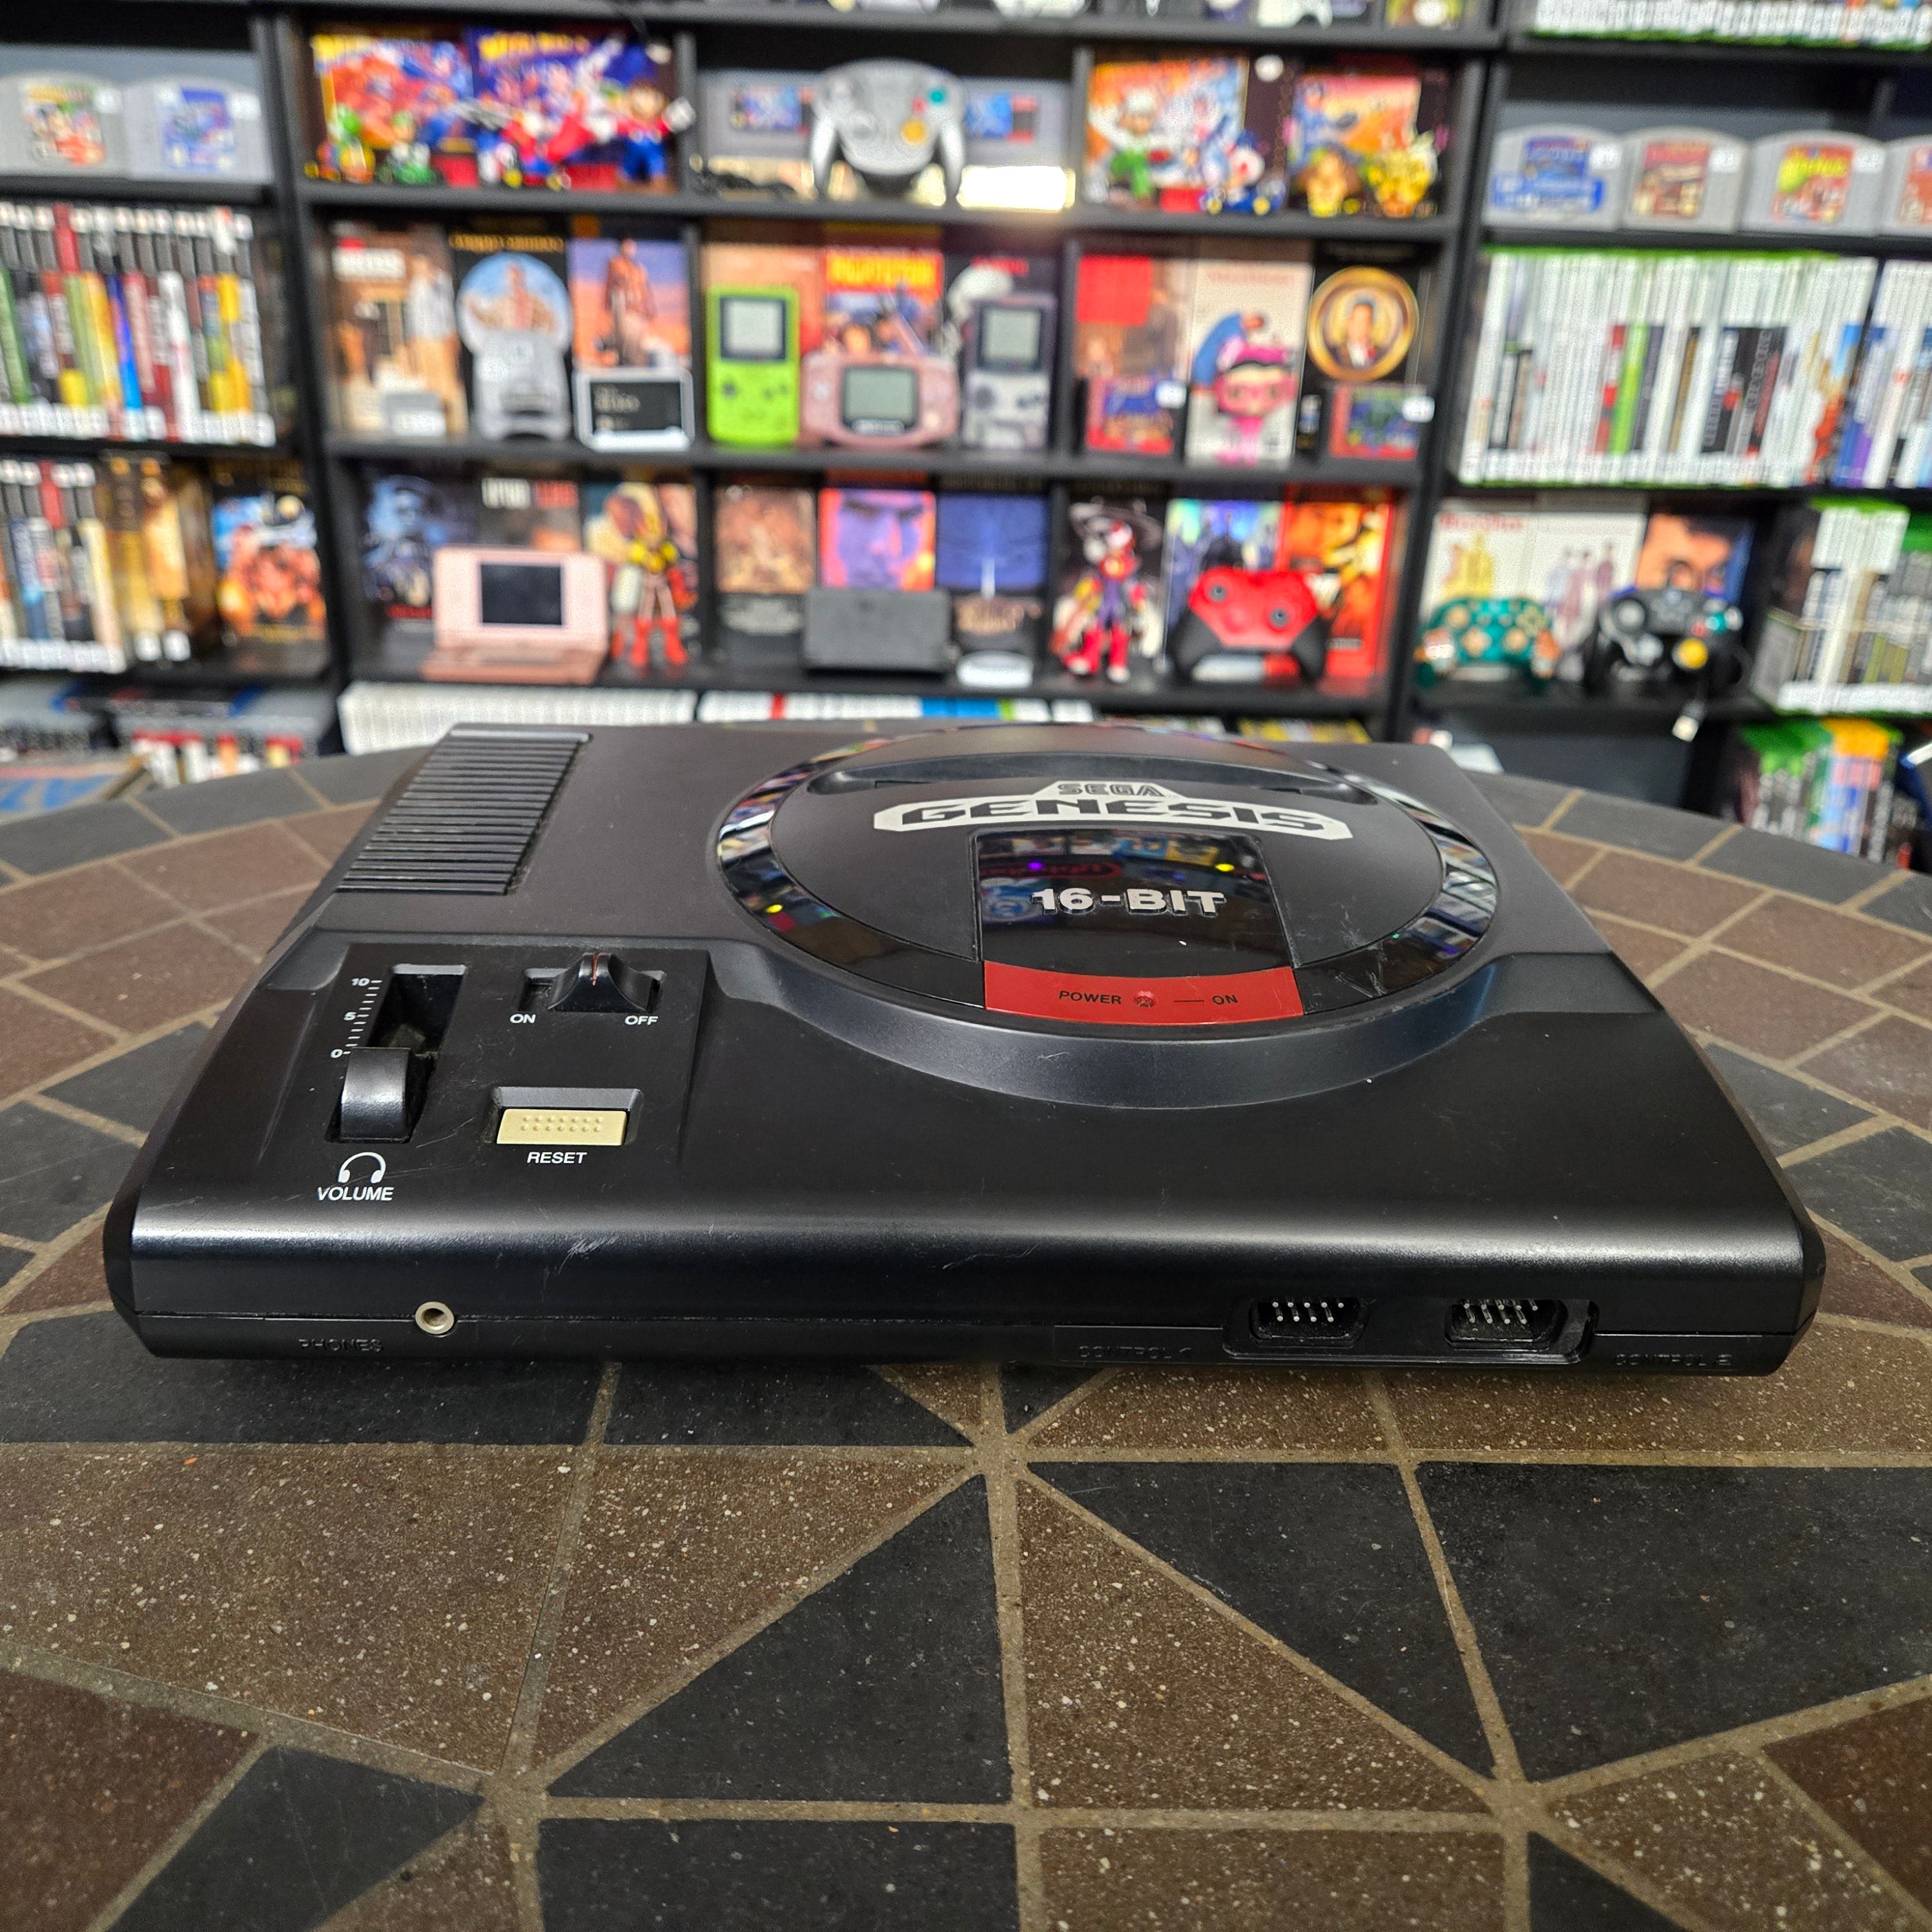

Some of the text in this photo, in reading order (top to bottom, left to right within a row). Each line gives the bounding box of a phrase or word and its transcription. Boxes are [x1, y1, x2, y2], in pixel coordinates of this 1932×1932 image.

[1058, 782, 1165, 797] SEGA
[901, 798, 1325, 831] GENESIS
[1031, 888, 1226, 916] 16-BIT
[351, 977, 369, 986] 10
[1058, 990, 1238, 1006] POWER ON
[344, 1011, 356, 1021] 5
[509, 1012, 659, 1025] ON OFF
[330, 1049, 343, 1058] 0
[526, 1151, 588, 1164] RESET
[316, 1186, 395, 1202] VOLUME
[299, 1338, 383, 1352] PHONES
[1078, 1345, 1172, 1359] CONTROL
[1615, 1353, 1707, 1366] CONTROL
